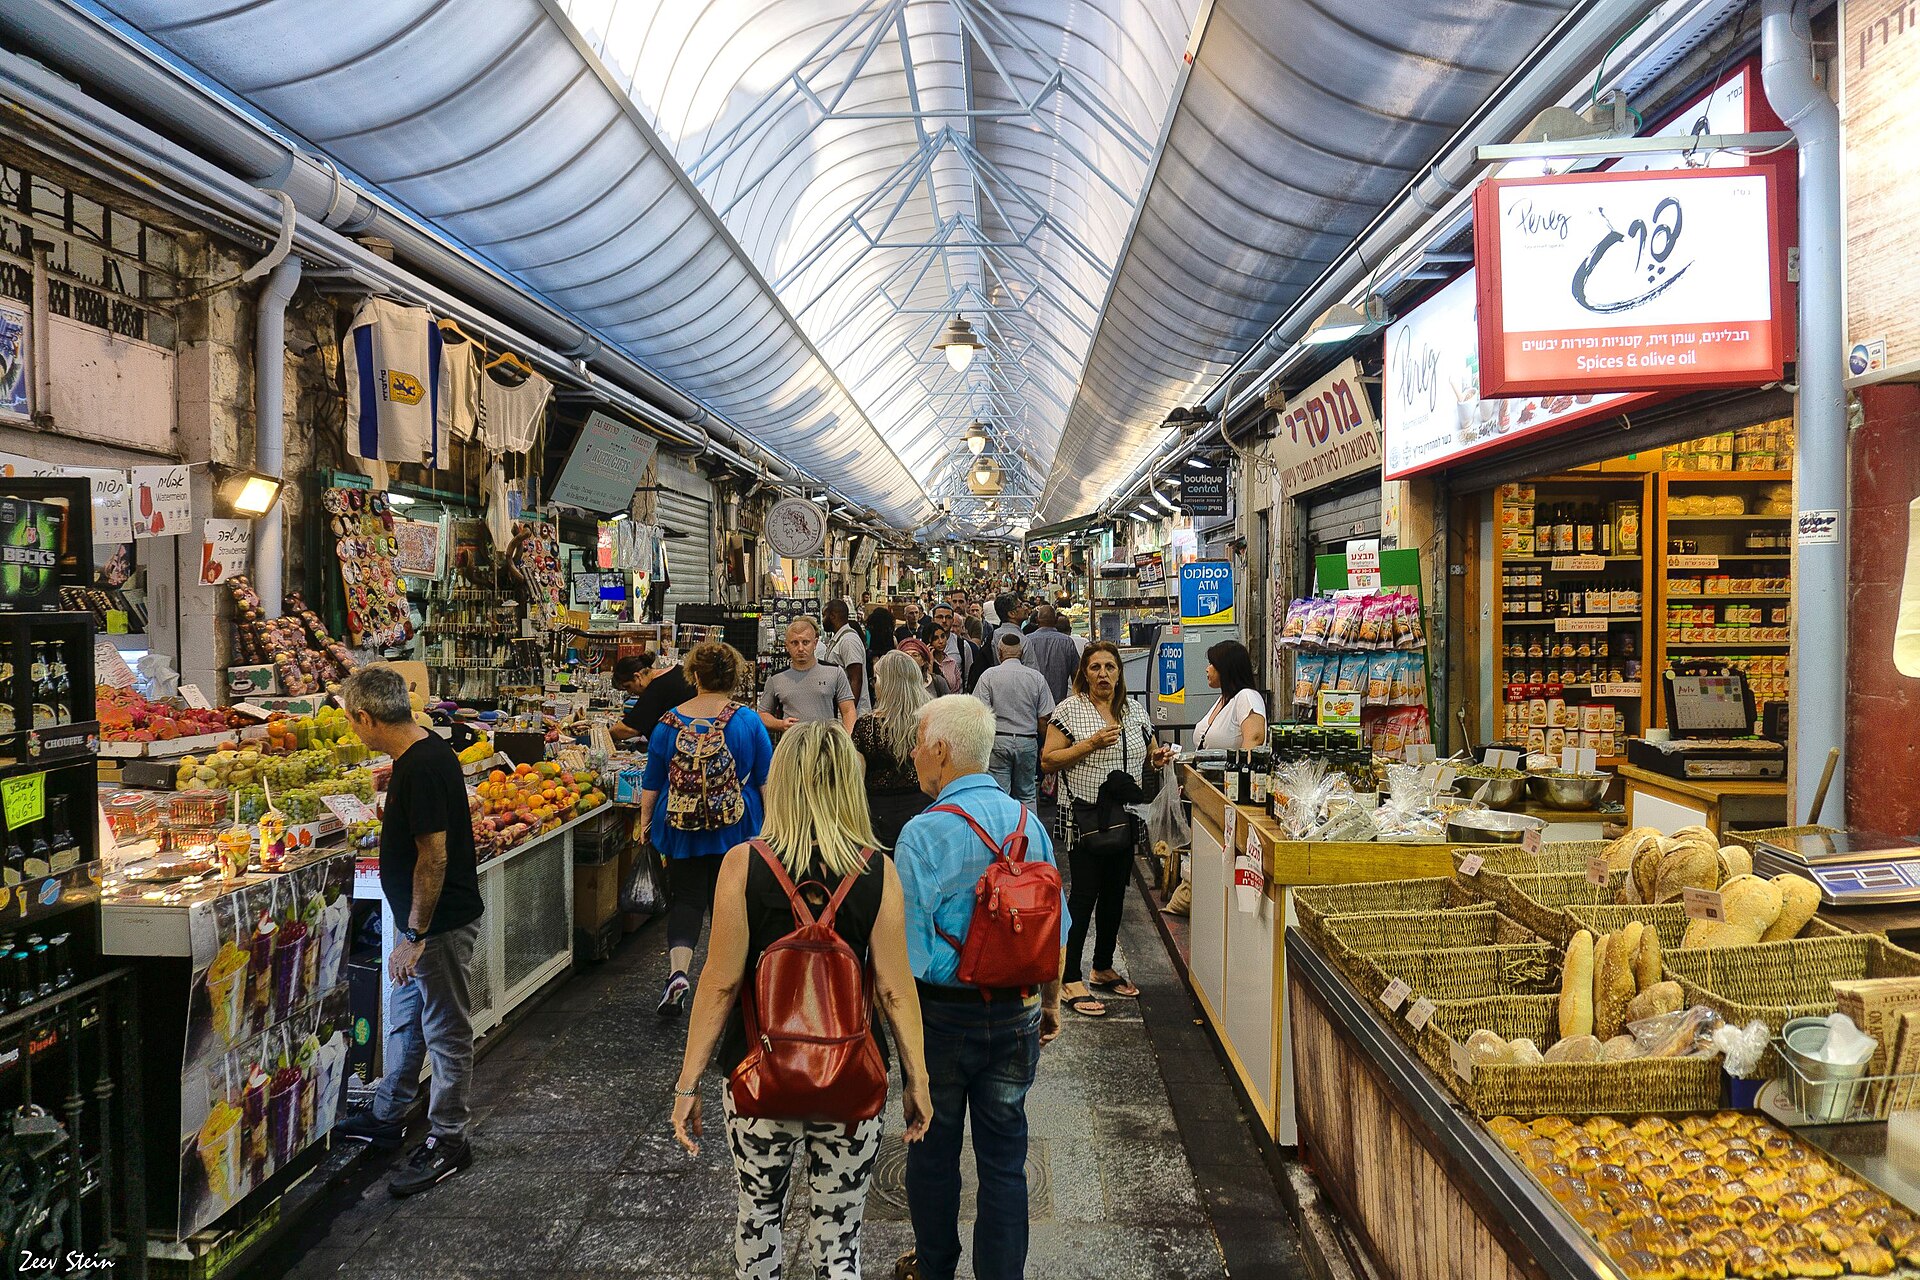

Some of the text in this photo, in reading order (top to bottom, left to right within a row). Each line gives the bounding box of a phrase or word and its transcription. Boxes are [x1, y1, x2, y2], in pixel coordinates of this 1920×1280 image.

[1508, 198, 1572, 240] Pereg
[1522, 329, 1749, 352] תבלינים, שמן זית, קטניות ופירות יבשים
[1577, 350, 1696, 371] Spices & olive oil
[1393, 325, 1440, 413] Pereg
[380, 369, 388, 401] ירושלים
[1284, 378, 1363, 448] מוסרי
[157, 468, 185, 488] אבטיח
[1184, 474, 1223, 485] boutique
[96, 480, 124, 494] תפוח
[1187, 484, 1219, 493] central
[156, 493, 187, 502] Watermelon
[218, 526, 237, 541] שדה
[1351, 552, 1375, 560] מבצע
[1184, 565, 1229, 579] כספומט
[1198, 580, 1219, 590] ATM
[1166, 660, 1177, 669] ATM
[44, 735, 84, 749] CHOUFFE
